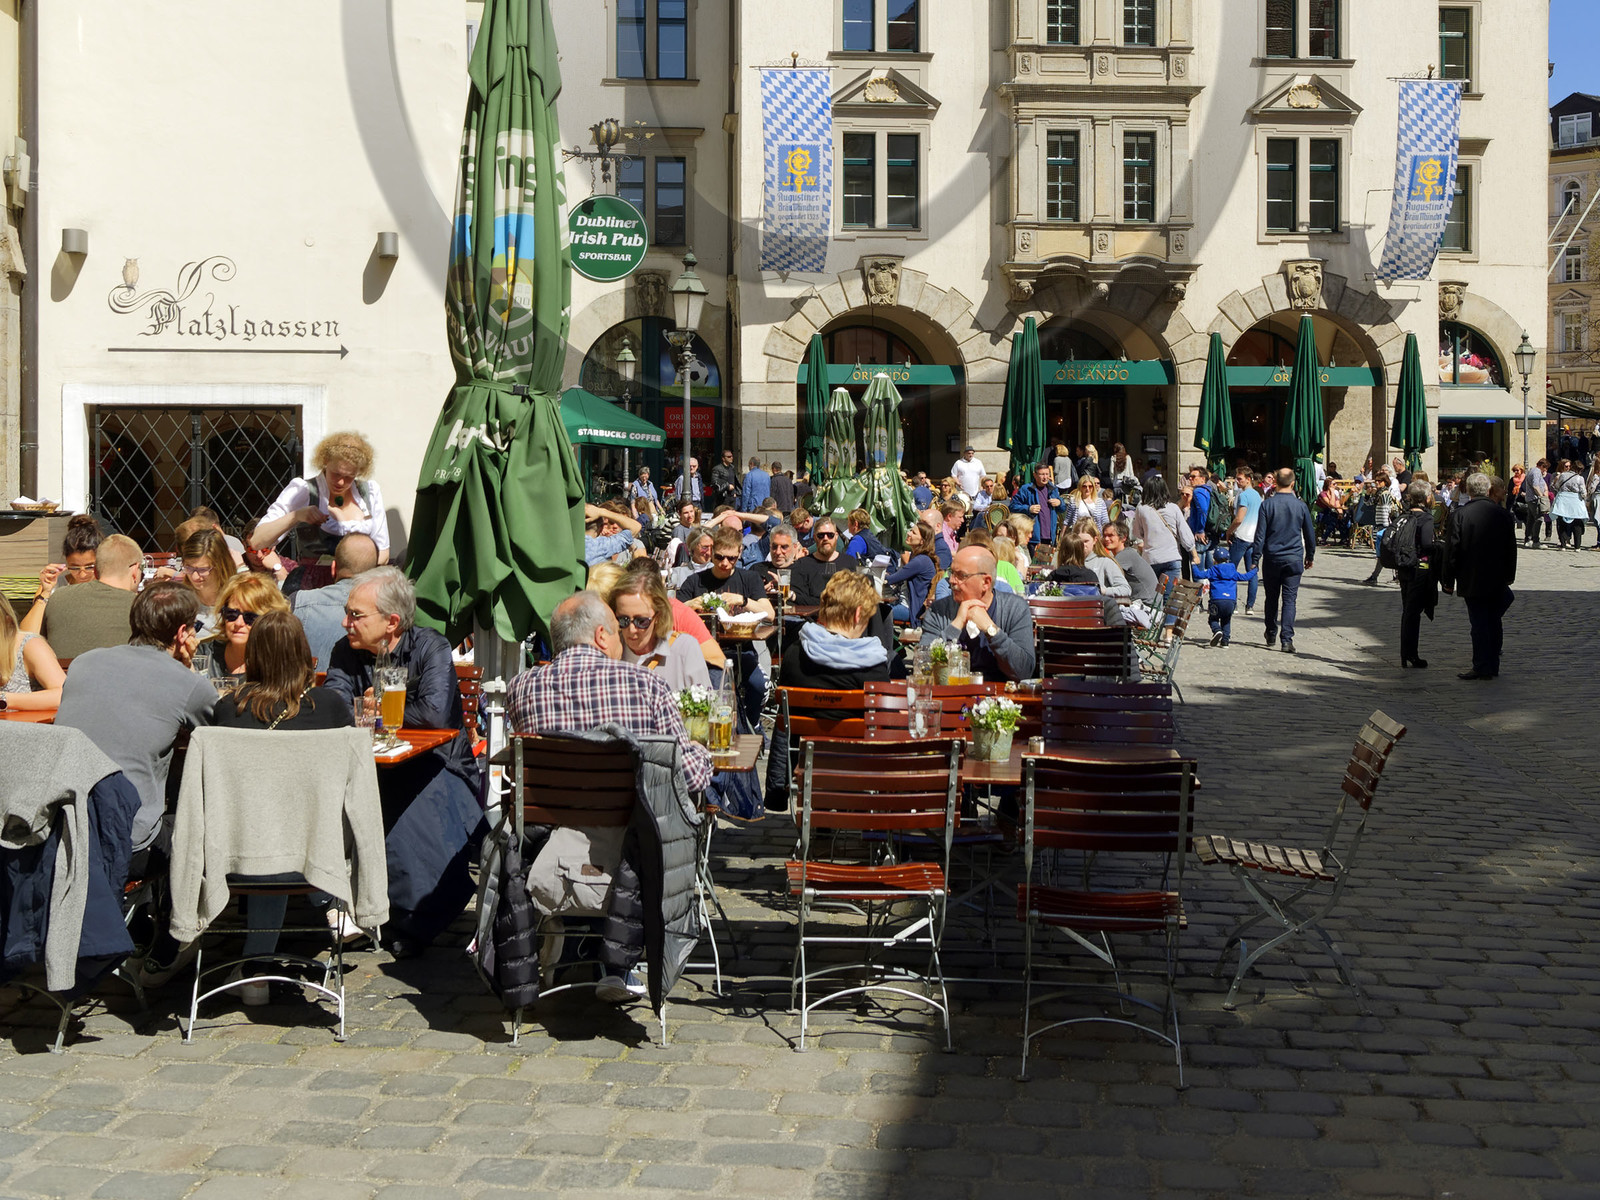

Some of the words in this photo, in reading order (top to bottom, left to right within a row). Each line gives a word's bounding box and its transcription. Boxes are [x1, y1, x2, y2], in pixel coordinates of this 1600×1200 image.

[777, 192, 820, 203] Augustiner
[1405, 202, 1444, 212] Augustinr
[576, 215, 639, 229] Dubliner
[569, 231, 607, 245] Irish
[611, 233, 644, 247] Pub
[578, 252, 632, 262] SPORTSBAR
[135, 285, 341, 342] Platzlgassen
[852, 371, 910, 381] ORLDO
[1055, 369, 1130, 381] ORLANDO
[669, 413, 710, 421] ORNDO
[666, 422, 713, 430] SPOSBAR
[577, 428, 627, 439] STARBUCKS
[629, 432, 662, 442] COFFEE
